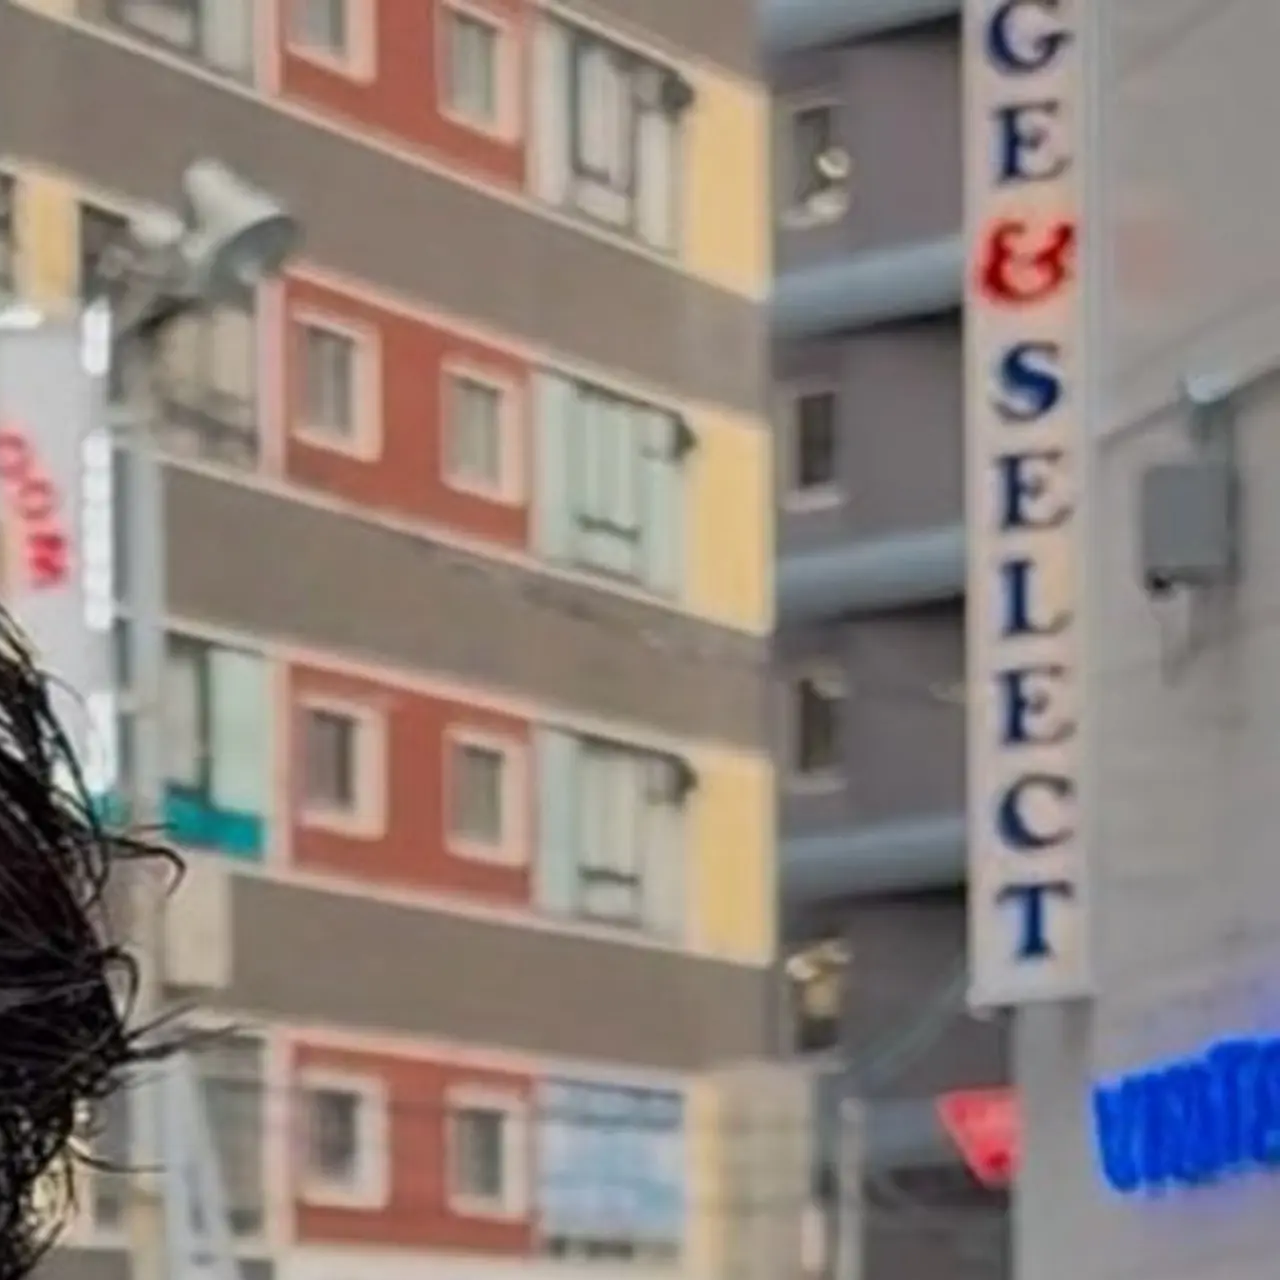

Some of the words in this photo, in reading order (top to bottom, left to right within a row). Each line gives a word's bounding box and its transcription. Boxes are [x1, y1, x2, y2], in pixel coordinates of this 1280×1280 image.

[987, 0, 1075, 188] GE
[979, 216, 1077, 308] &
[991, 340, 1077, 962] SELECT
